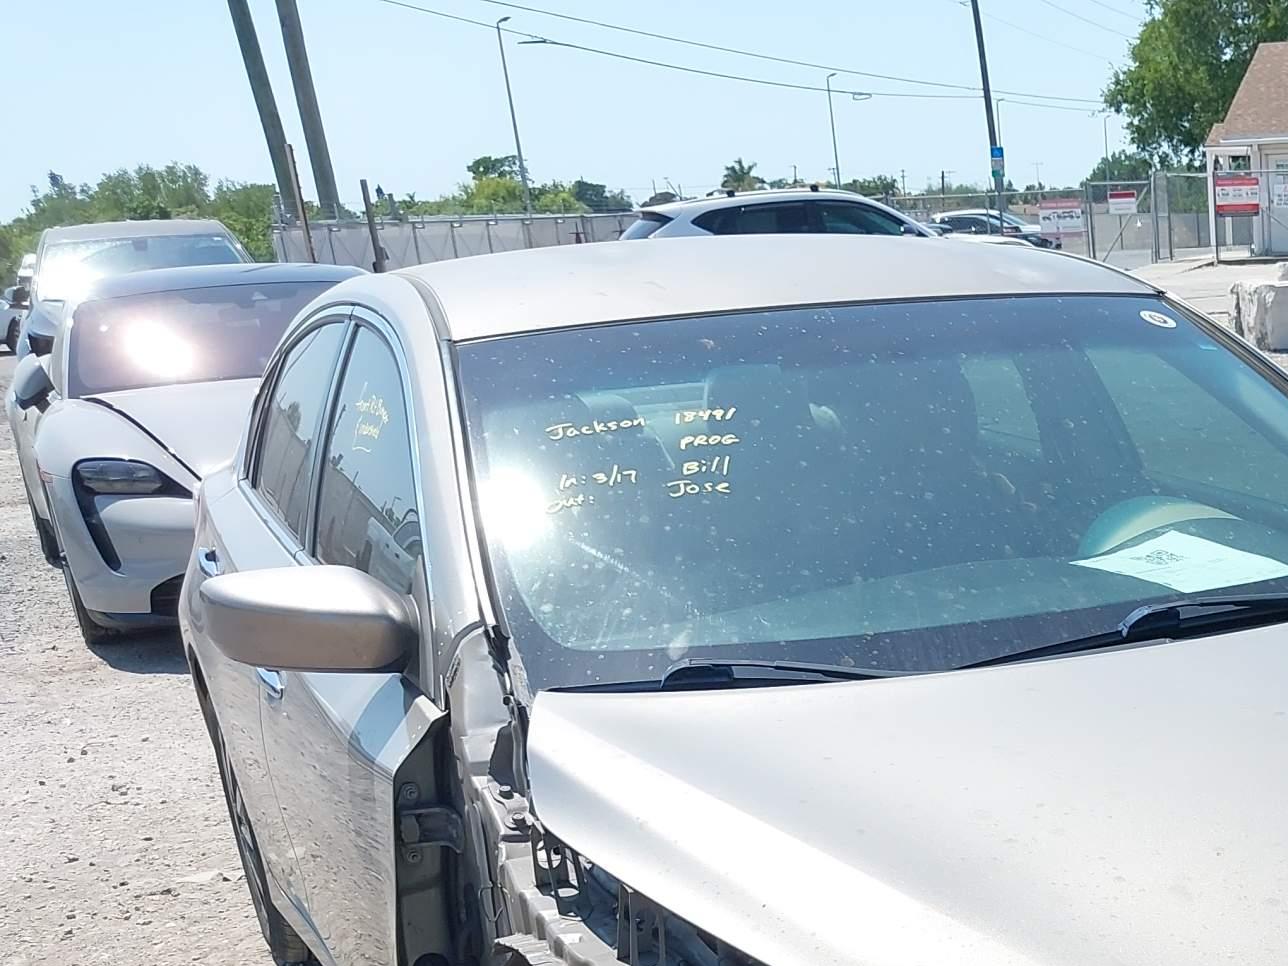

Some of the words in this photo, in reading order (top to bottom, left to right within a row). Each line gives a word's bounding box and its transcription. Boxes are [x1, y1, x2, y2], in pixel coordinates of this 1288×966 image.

[545, 416, 646, 440] Jackson
[679, 433, 741, 451] PROG
[592, 464, 638, 487] 3/17
[682, 455, 731, 476] Bill
[667, 479, 731, 498] Jose
